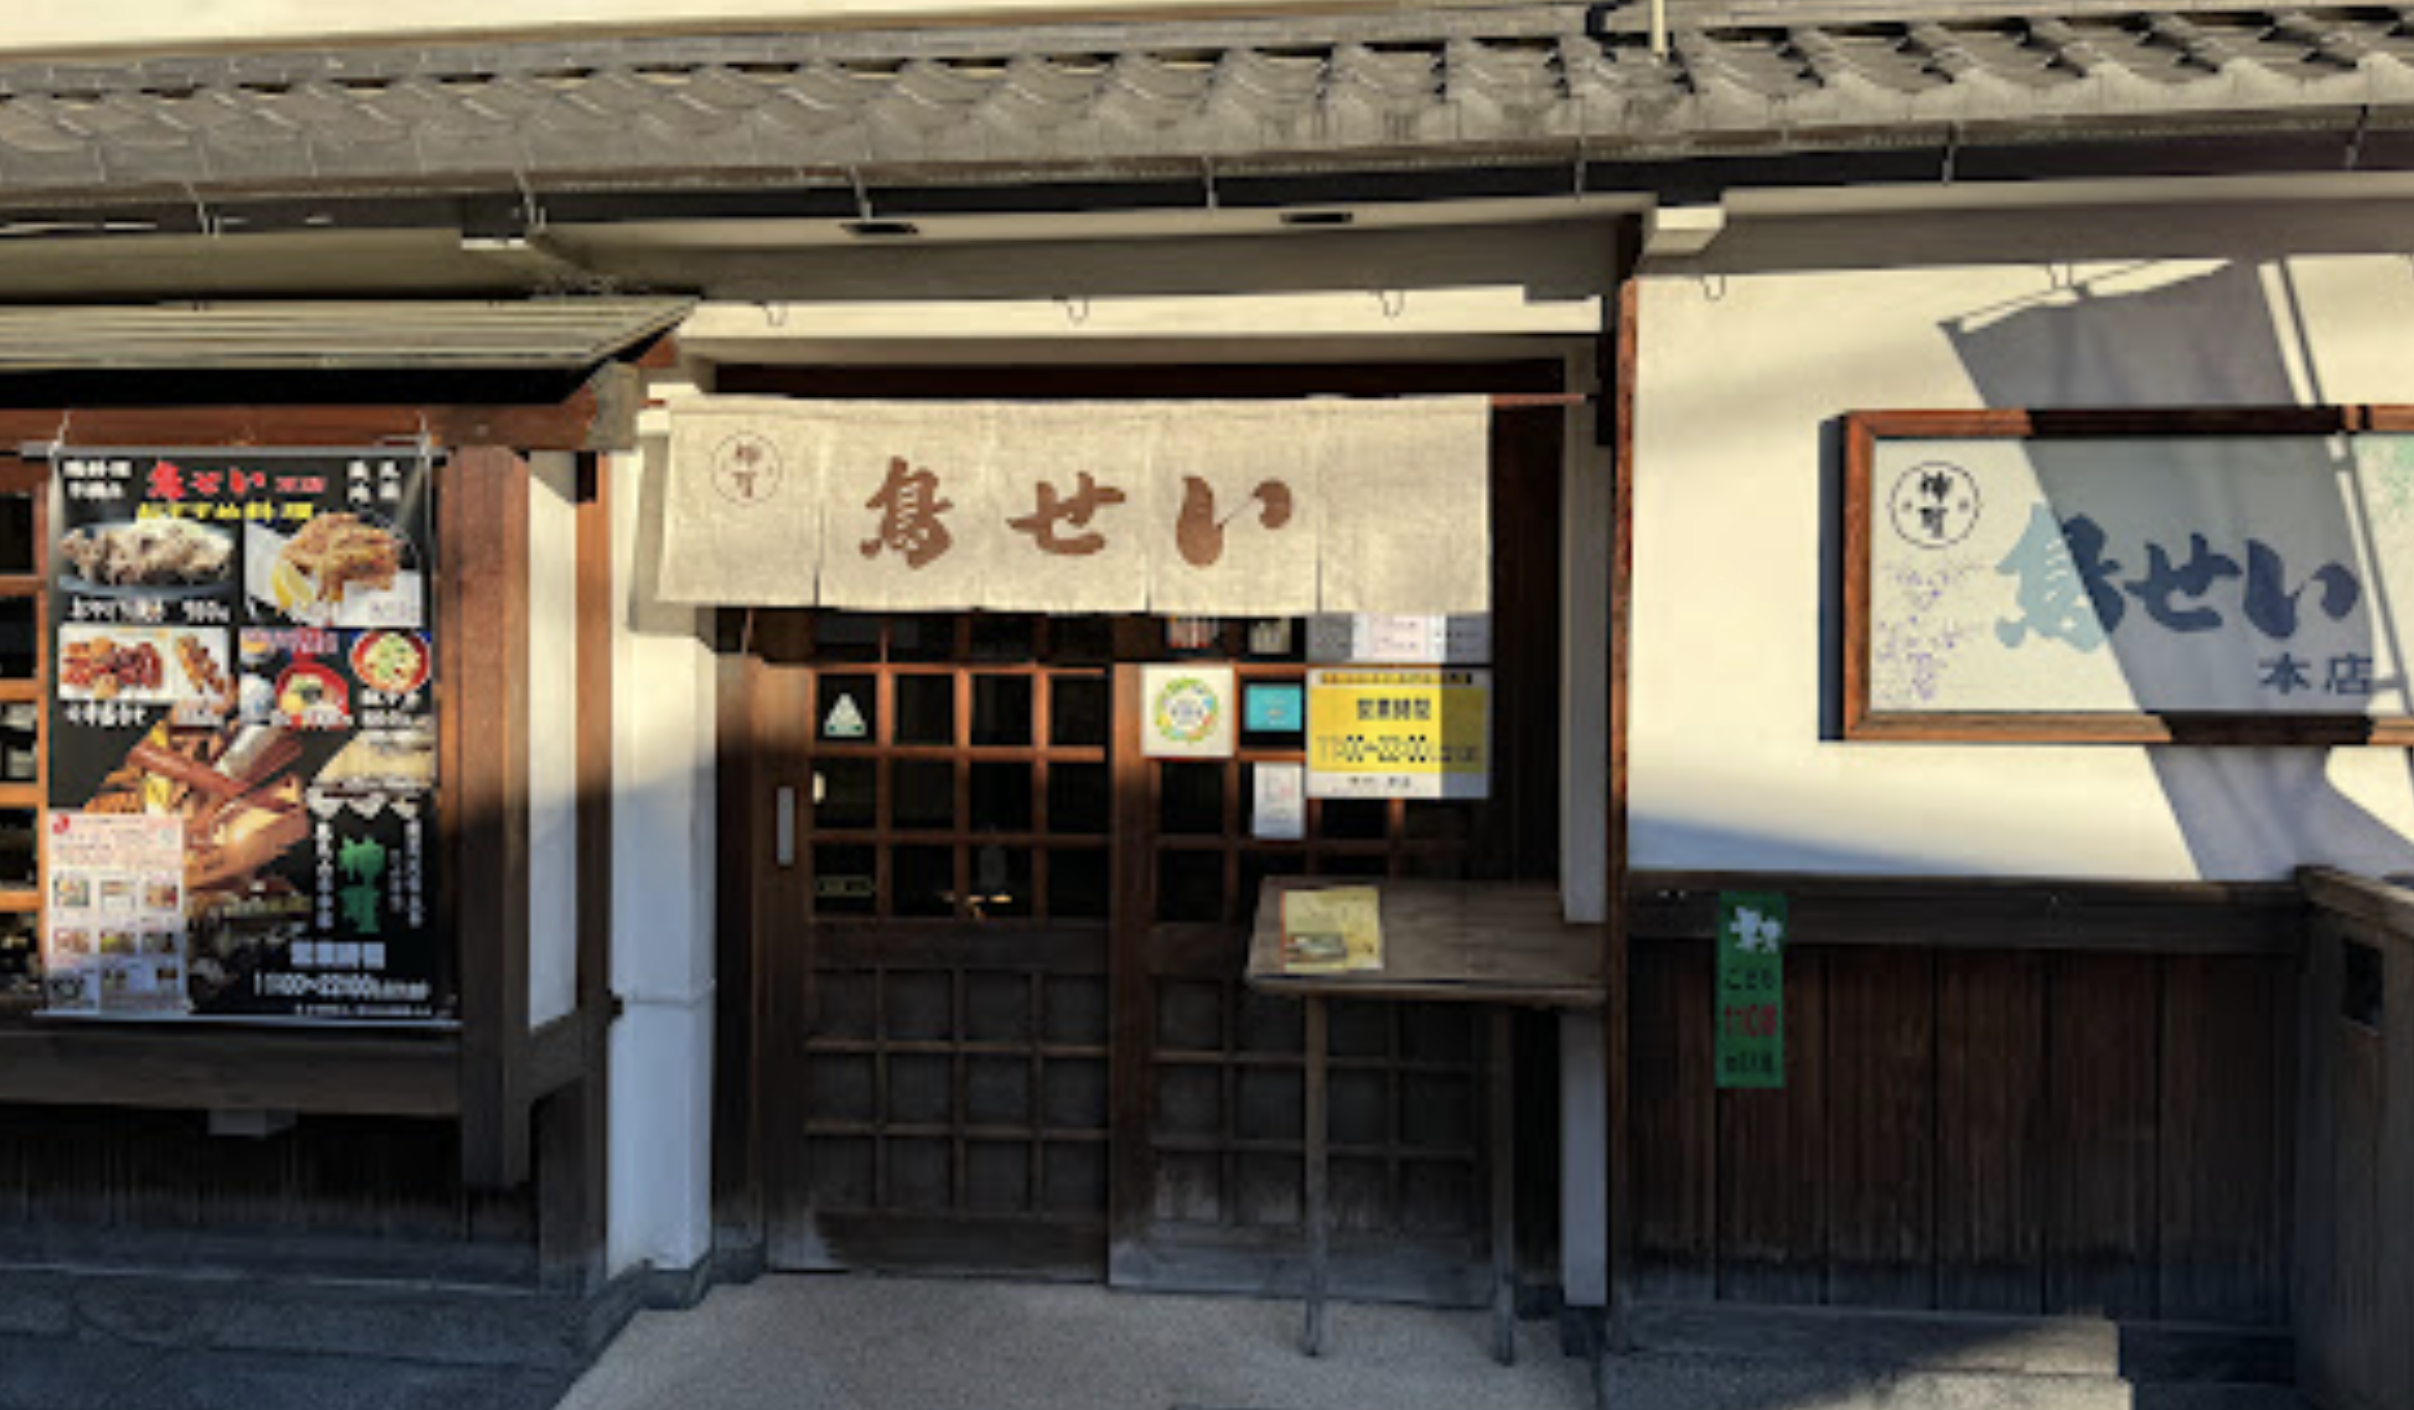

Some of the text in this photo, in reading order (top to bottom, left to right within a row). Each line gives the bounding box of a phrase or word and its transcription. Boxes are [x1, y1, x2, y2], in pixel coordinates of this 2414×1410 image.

[860, 456, 1293, 568] 鳥せい
[1994, 502, 2363, 654] 鳥せい
[2257, 652, 2375, 695] 本店
